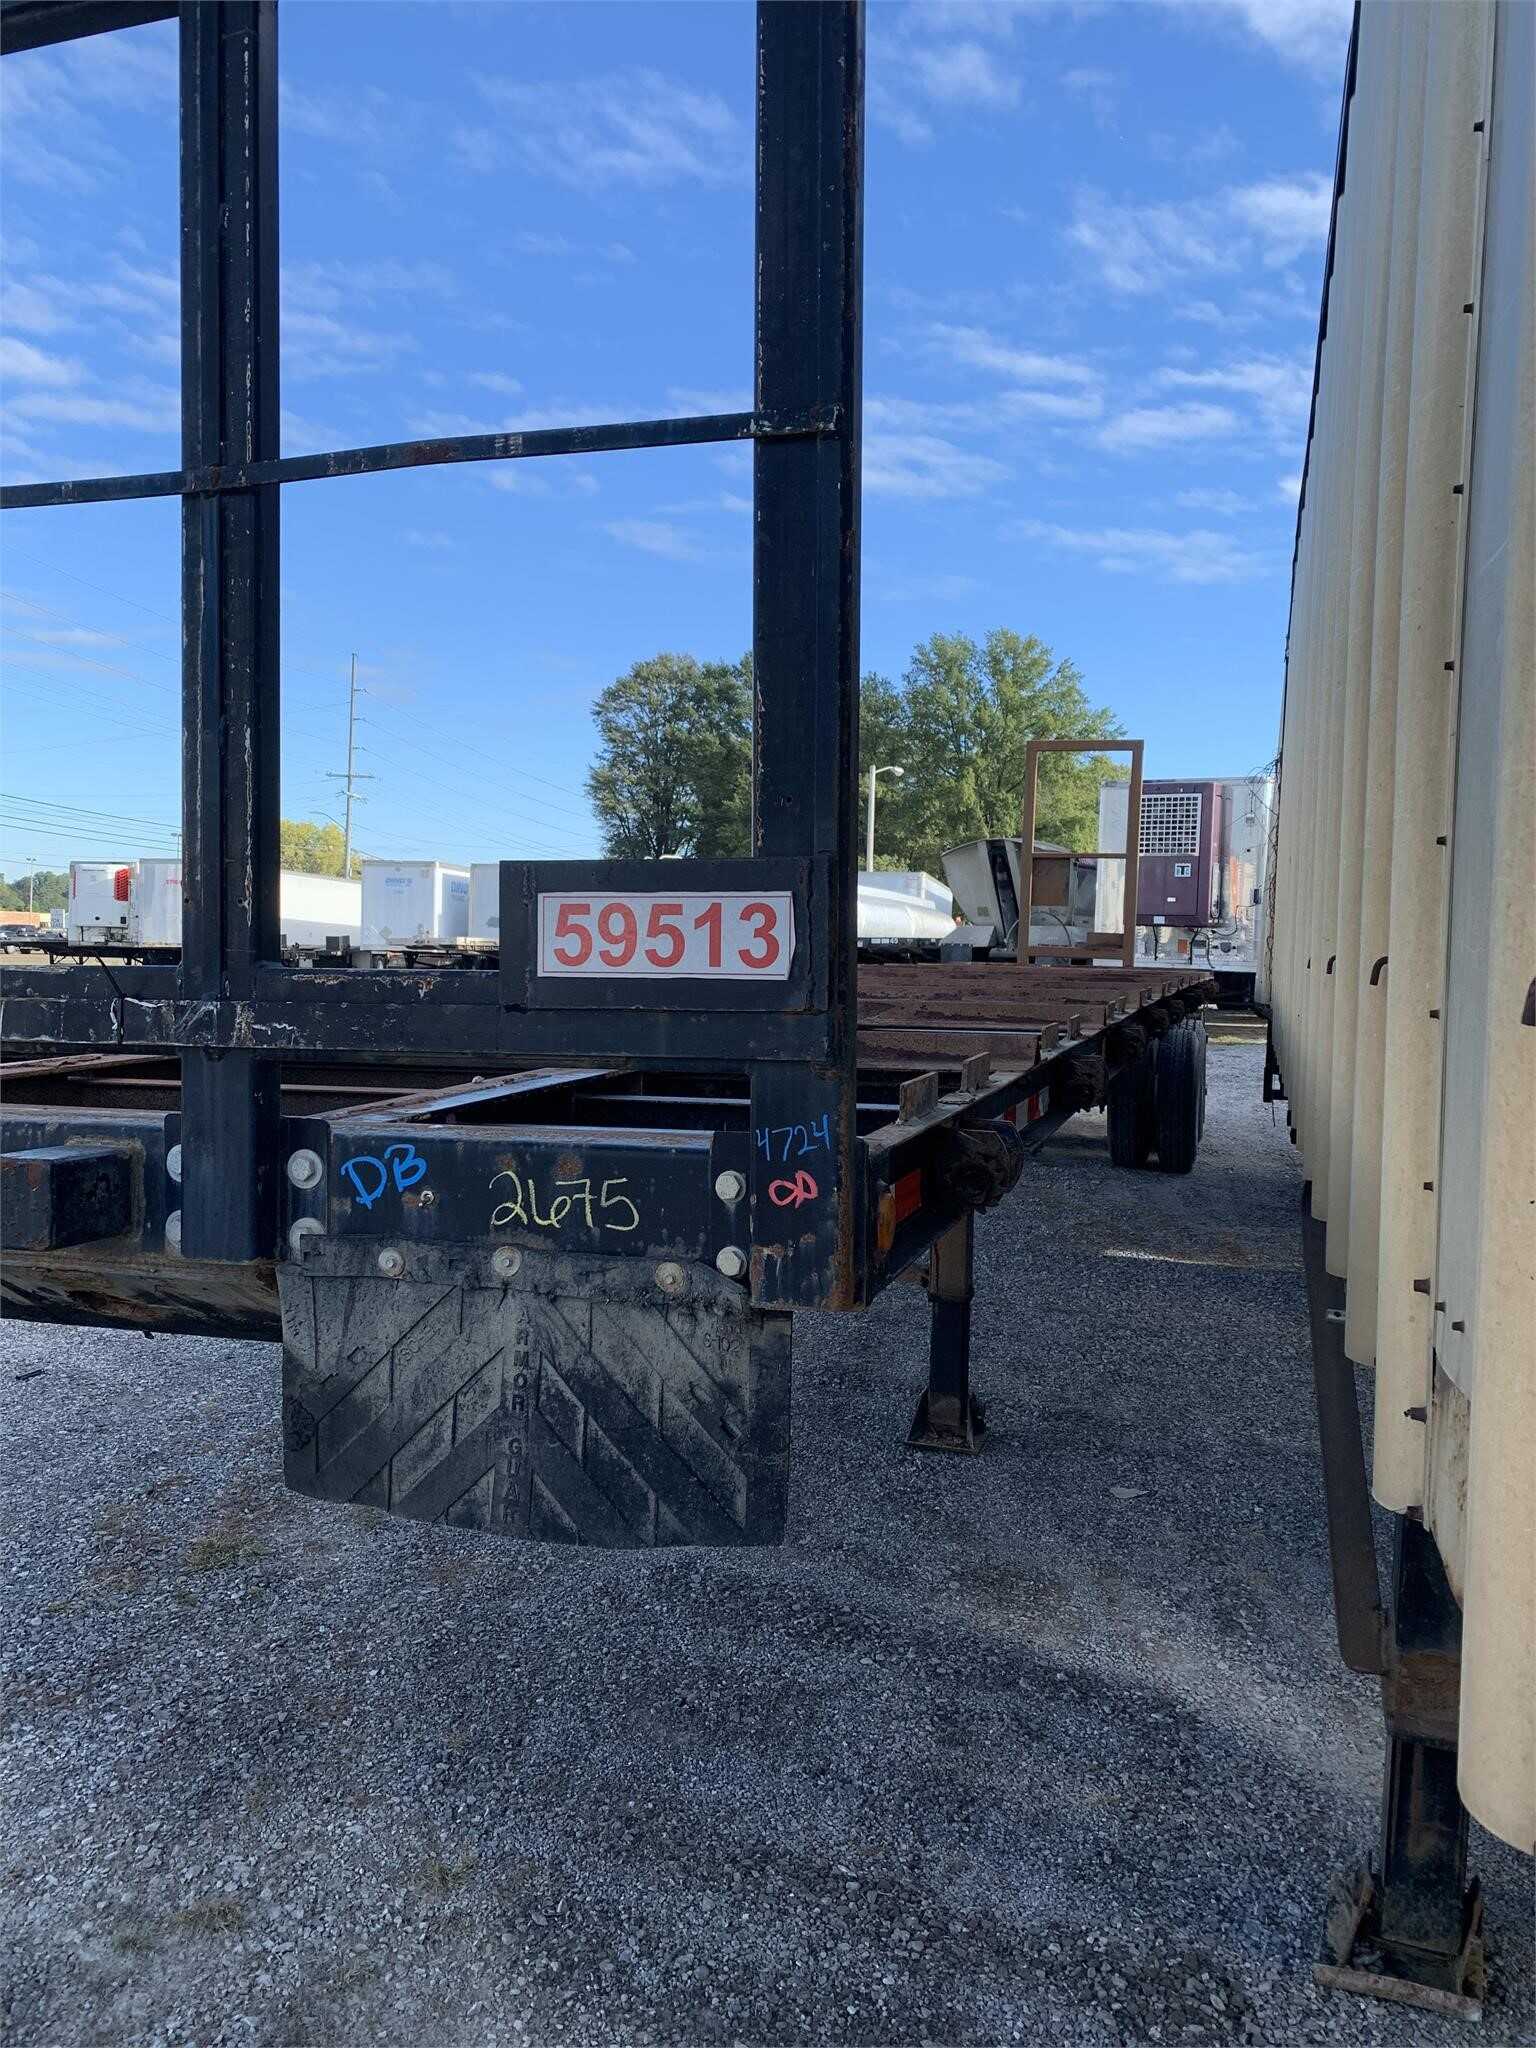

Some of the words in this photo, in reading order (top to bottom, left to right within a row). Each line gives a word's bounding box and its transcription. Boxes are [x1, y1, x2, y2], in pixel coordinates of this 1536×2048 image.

[553, 902, 780, 969] 59513
[756, 1113, 831, 1162] 4724
[340, 1143, 428, 1210] DB
